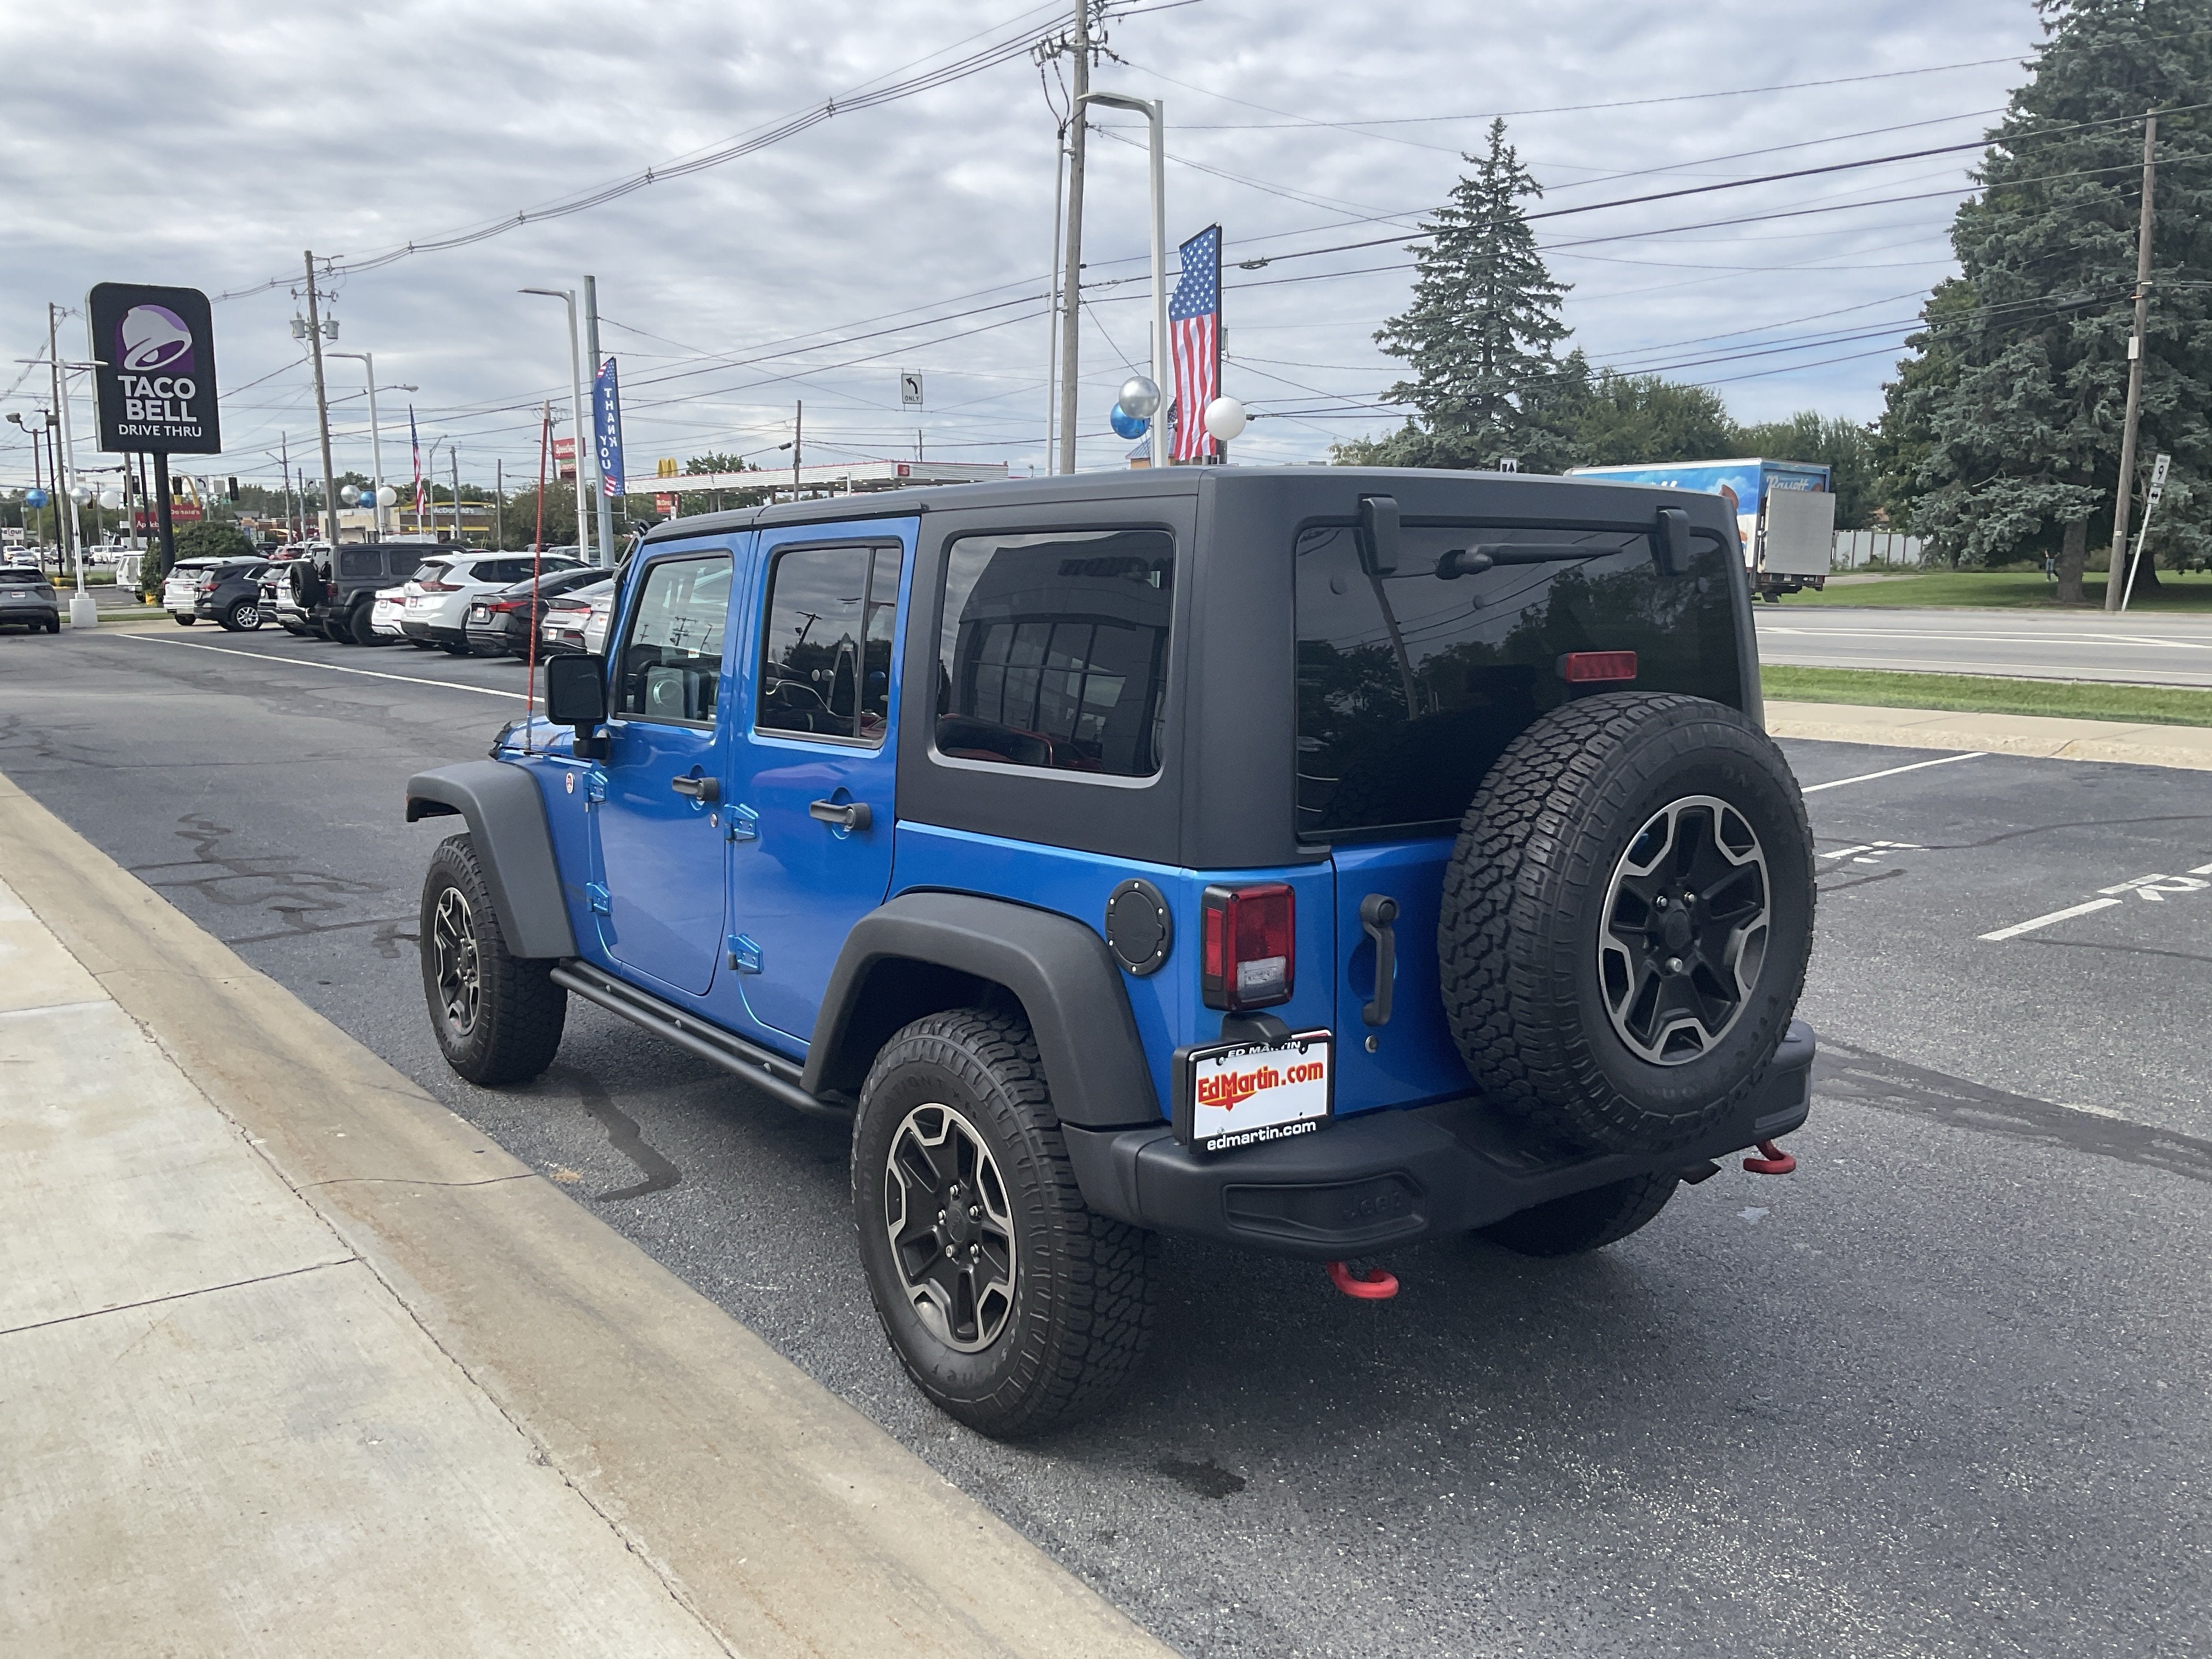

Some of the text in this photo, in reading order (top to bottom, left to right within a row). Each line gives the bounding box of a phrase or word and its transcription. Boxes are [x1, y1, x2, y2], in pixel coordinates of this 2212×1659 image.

[117, 375, 196, 399] TACO
[126, 399, 197, 422] BELL
[119, 424, 202, 437] DRIVE THRU
[1198, 1062, 1323, 1103] EdMartin.com
[1207, 1121, 1316, 1150] edmartin.com
